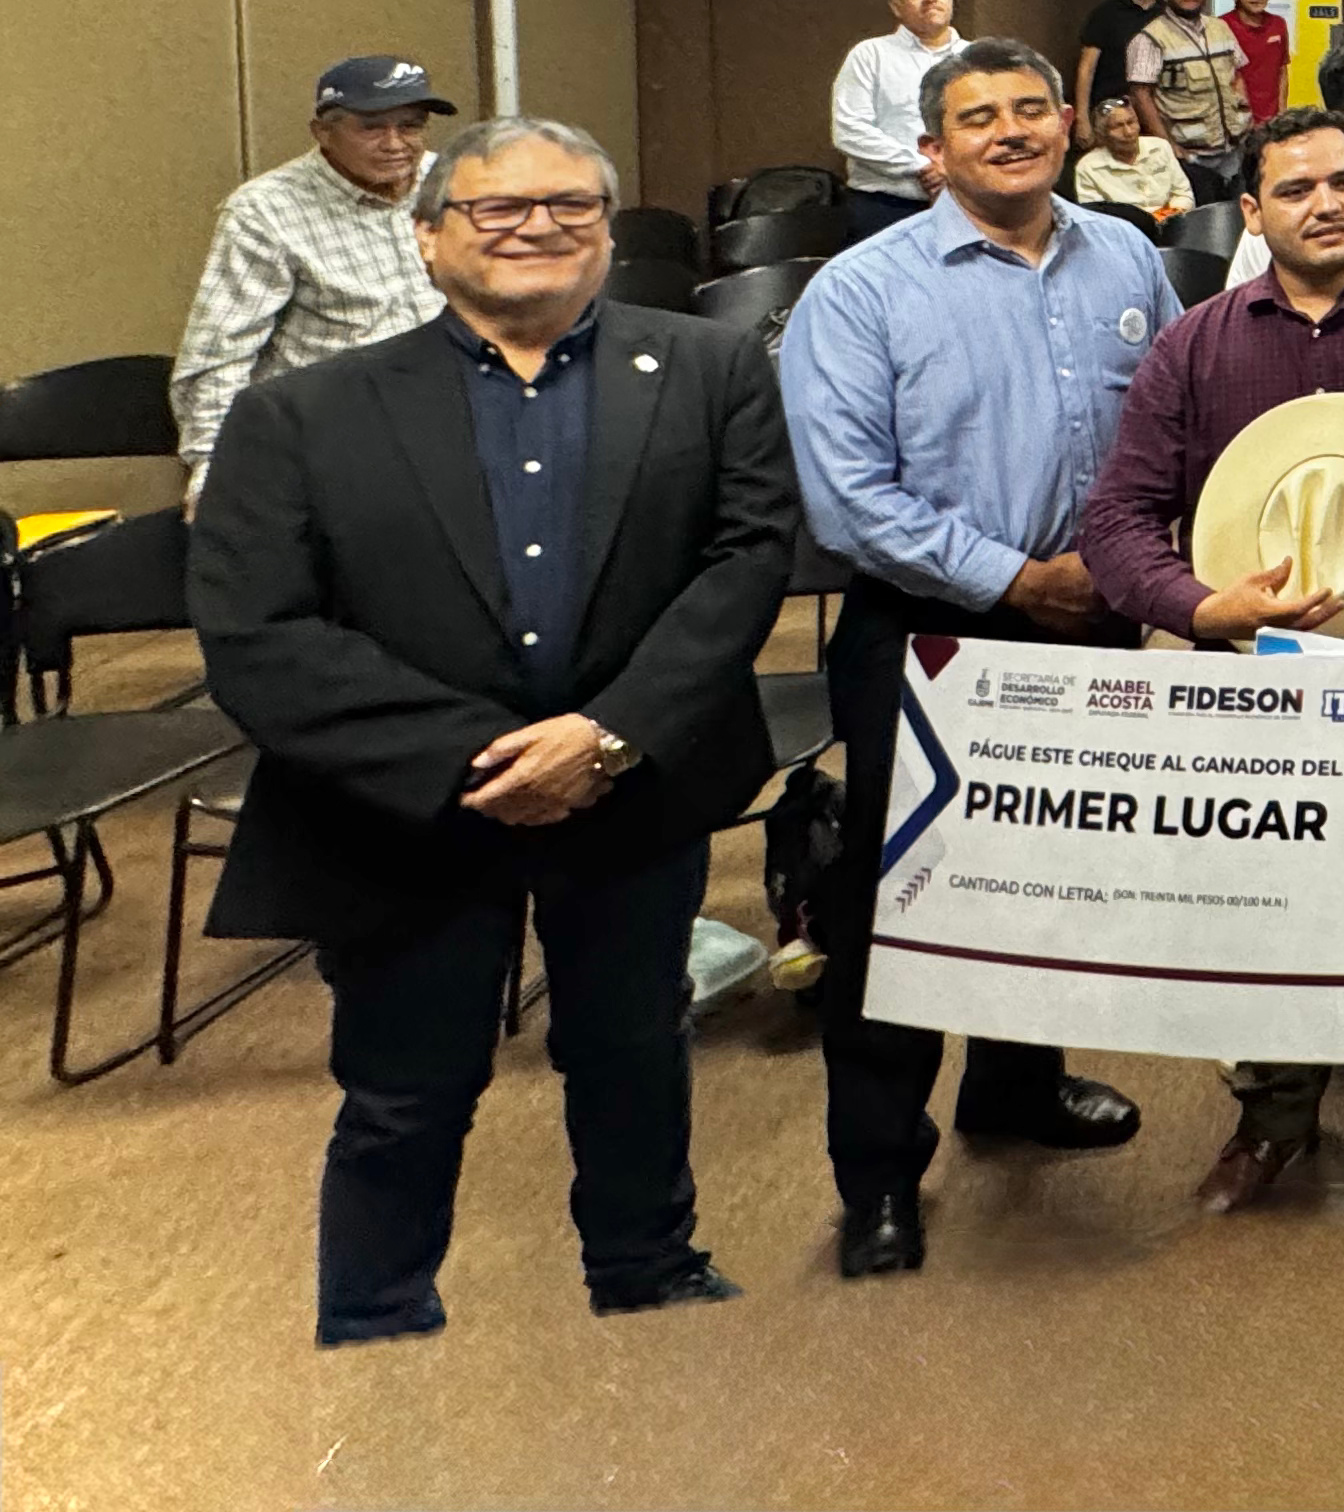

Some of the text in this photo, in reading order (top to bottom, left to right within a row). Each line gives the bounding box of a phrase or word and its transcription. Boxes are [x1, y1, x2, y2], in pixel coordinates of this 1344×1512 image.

[1001, 683, 1065, 696] DESARROLLO
[1063, 676, 1076, 687] DE
[1088, 678, 1155, 696] ANABEL
[1000, 694, 1059, 707] ECONÓMICO
[1086, 693, 1154, 710] ACOSTA
[1168, 685, 1303, 713] FIDESON
[968, 738, 1343, 777] PÁGUE ESTE CHEQUE AL GANADOR DEL
[964, 780, 1328, 841] PRIMER LUGAR
[949, 874, 1020, 895] CANTIDAD
[1023, 881, 1054, 898] CON
[1058, 885, 1108, 903] LETRA:
[1140, 891, 1176, 903] TREINTA
[1196, 894, 1225, 906] PESOS
